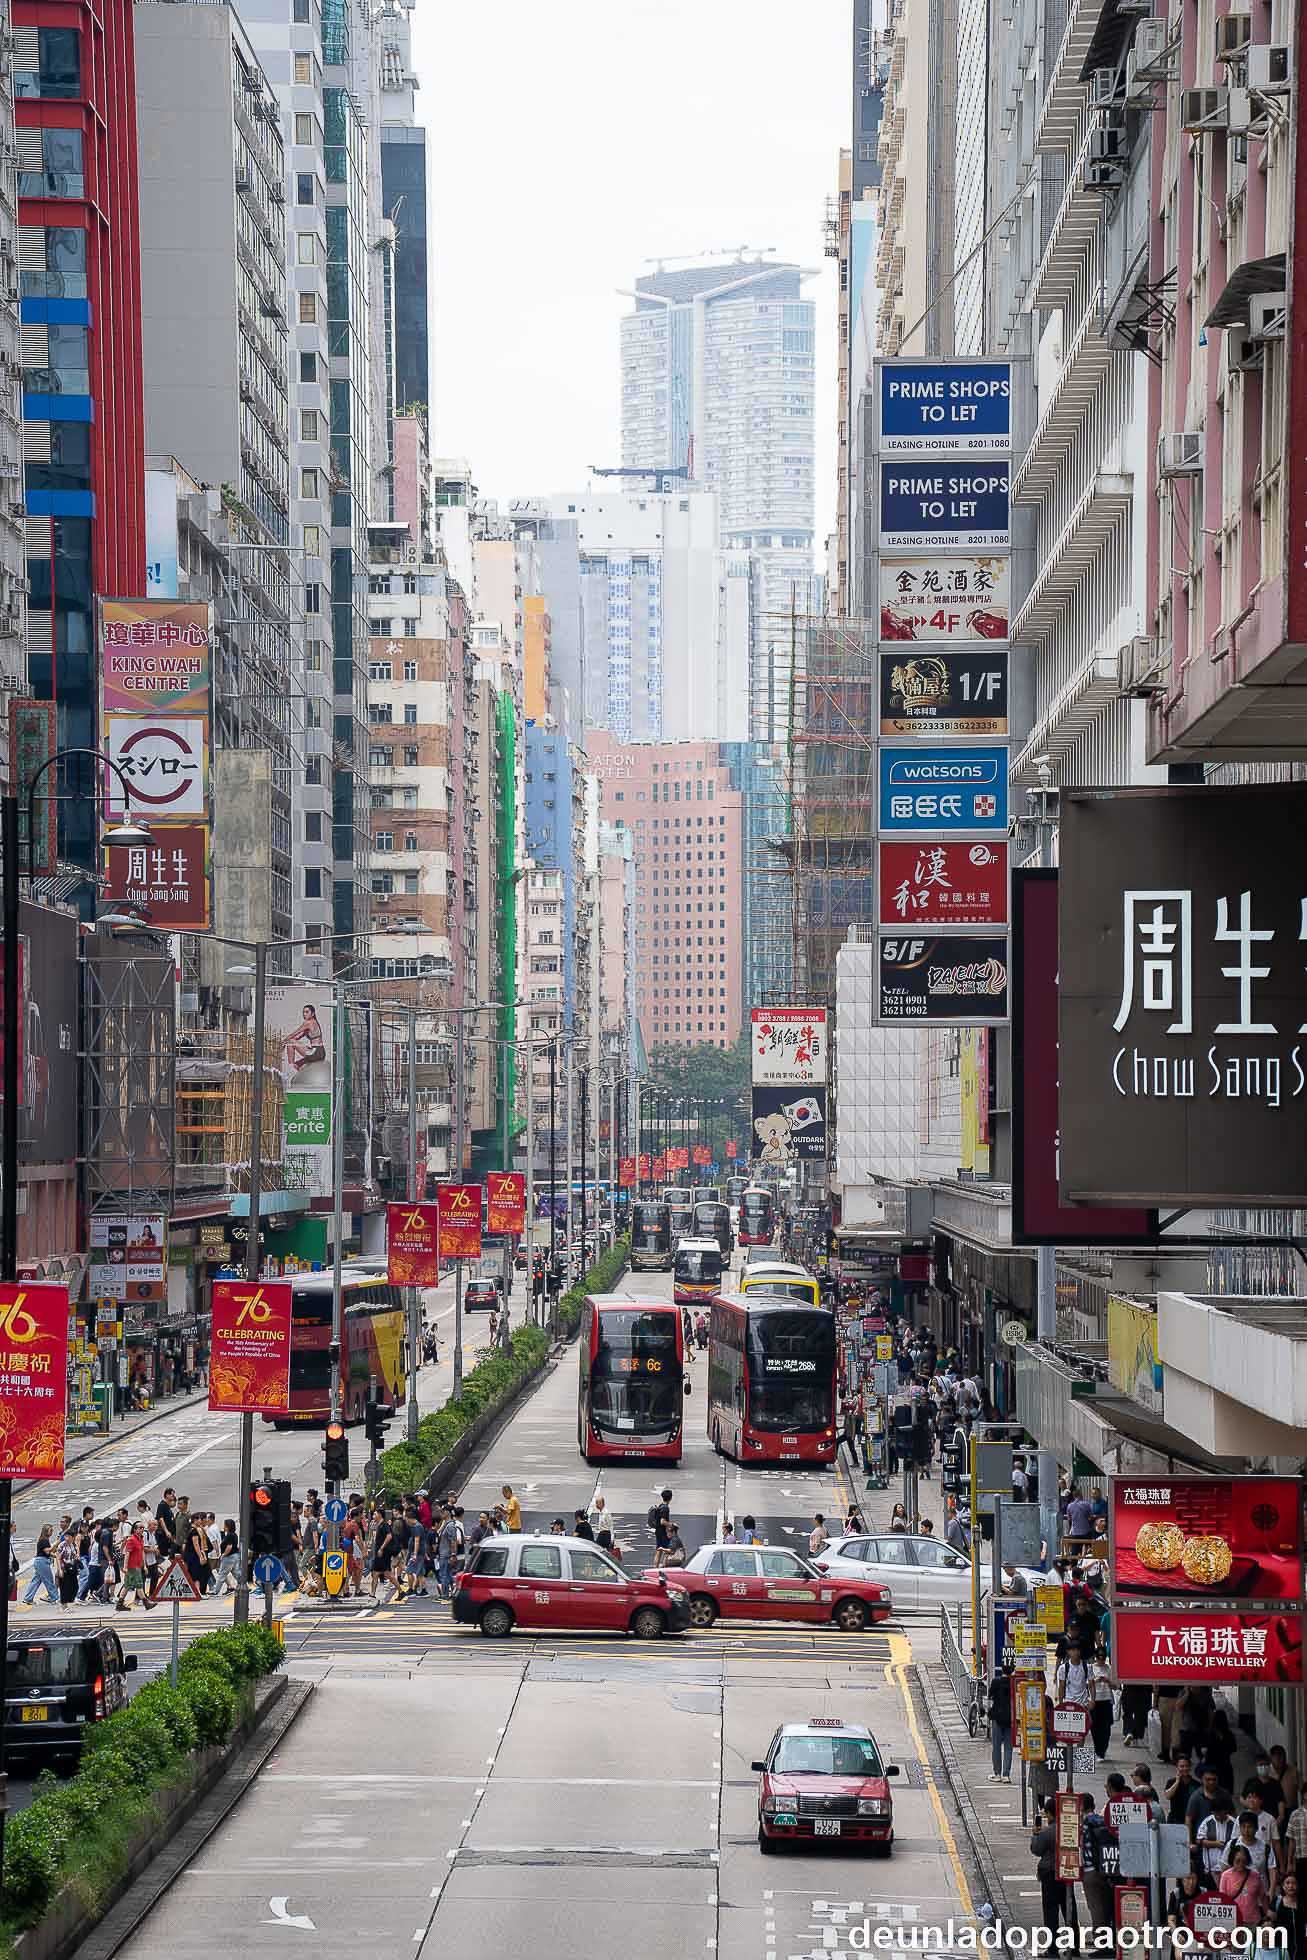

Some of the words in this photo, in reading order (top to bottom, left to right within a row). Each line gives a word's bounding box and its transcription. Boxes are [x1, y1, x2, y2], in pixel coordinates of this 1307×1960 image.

[889, 381, 944, 398] PRIME
[950, 380, 1010, 398] SHOPS
[920, 405, 945, 422] TO
[951, 405, 978, 421] LET
[887, 440, 923, 449] LEASING
[925, 440, 959, 449] HOTLINE
[968, 439, 988, 448] 8201
[989, 439, 1010, 448] 1080
[888, 478, 943, 495] PRIME
[949, 477, 1009, 494] SHOPS
[919, 502, 945, 518] TO
[951, 501, 978, 517] LET
[887, 537, 923, 545] LEASING
[925, 537, 959, 545] HOTLINE
[967, 536, 987, 545] 8201
[989, 536, 1009, 545] 1080
[895, 569, 995, 593] 金苑酒家
[929, 609, 961, 633] 4F
[104, 622, 208, 648] 瓊華中心
[111, 656, 155, 673] KING
[160, 657, 201, 673] WAH
[122, 676, 190, 691] CENTRE
[959, 672, 1002, 701] 1/F
[905, 707, 937, 716] 日本料理
[904, 765, 982, 778] watsons
[890, 795, 962, 819] 屈臣氏
[126, 847, 189, 886] 周生生
[126, 888, 148, 900] Chow
[149, 887, 169, 902] Sang
[170, 887, 189, 903] Sang
[882, 940, 925, 961] 5/F
[1112, 890, 1307, 1034] 周生
[882, 996, 904, 1005] 3621
[882, 1006, 904, 1015] 3621
[905, 1006, 928, 1015] 0902
[1112, 1047, 1194, 1096] Chow
[1207, 1045, 1281, 1107] Sang
[496, 1176, 516, 1193] 76
[448, 1188, 472, 1209] 76
[400, 1207, 425, 1232] 76
[232, 1288, 272, 1326] 76
[217, 1328, 286, 1341] CELEBRATING
[1123, 1487, 1172, 1500] 六福珠寶
[1151, 1625, 1268, 1656] 六福珠寶
[1151, 1655, 1203, 1666] LUKFOOK
[1205, 1656, 1268, 1668] JEWELLERY
[1046, 1748, 1064, 1759] MK
[1046, 1759, 1065, 1770] 176
[1132, 1804, 1142, 1813] 44
[1196, 1906, 1213, 1917] 60X
[1217, 1906, 1233, 1918] 69X
